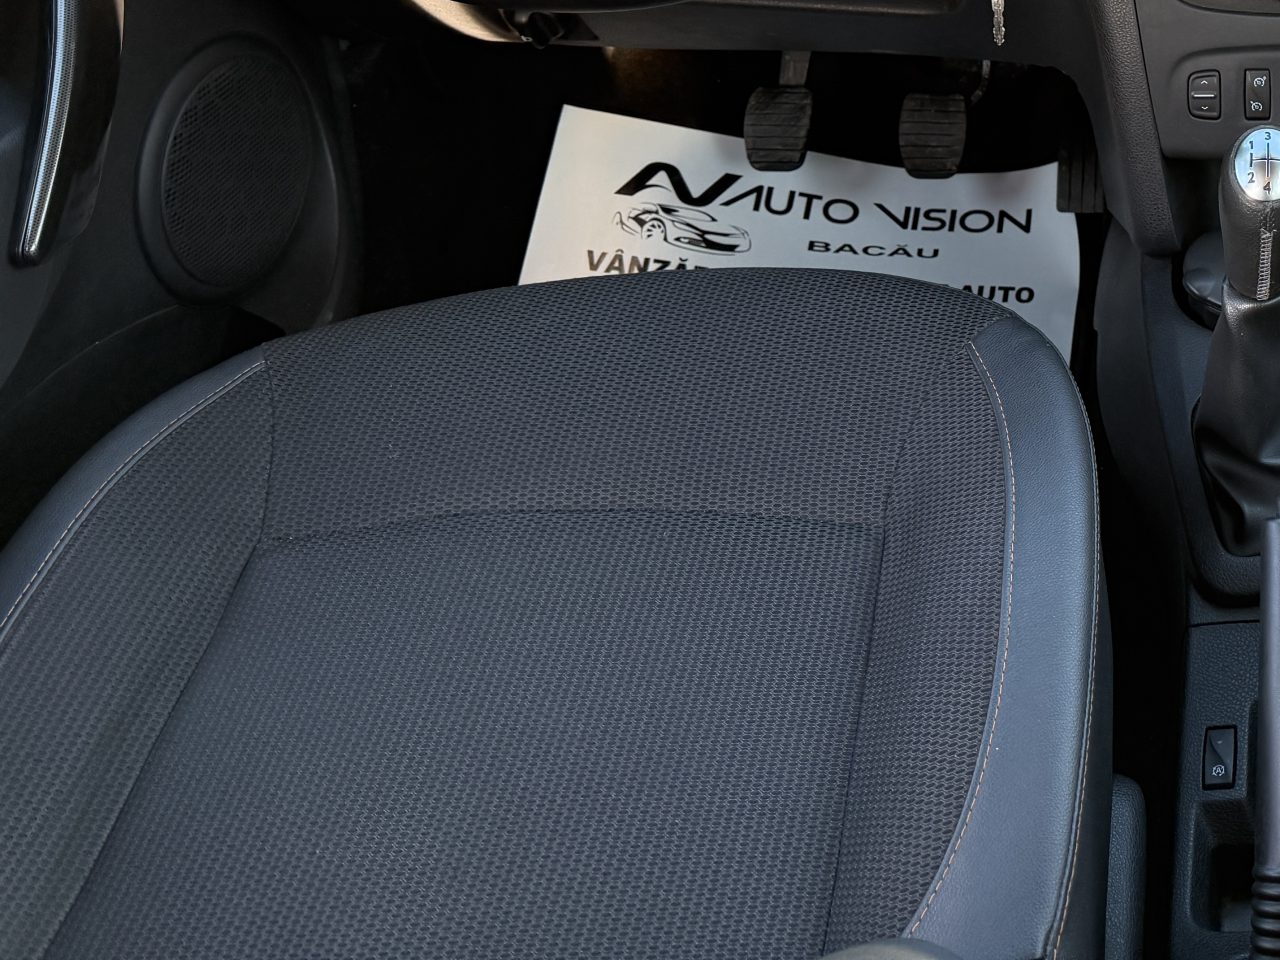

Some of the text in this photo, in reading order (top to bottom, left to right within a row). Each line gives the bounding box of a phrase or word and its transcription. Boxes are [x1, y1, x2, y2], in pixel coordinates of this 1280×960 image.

[1248, 140, 1254, 150] 1
[1264, 131, 1272, 141] 3
[1247, 171, 1255, 184] 2
[1263, 181, 1271, 195] 4
[719, 184, 860, 225] AUTO
[873, 202, 1033, 234] VISION
[807, 239, 940, 259] BACĂU
